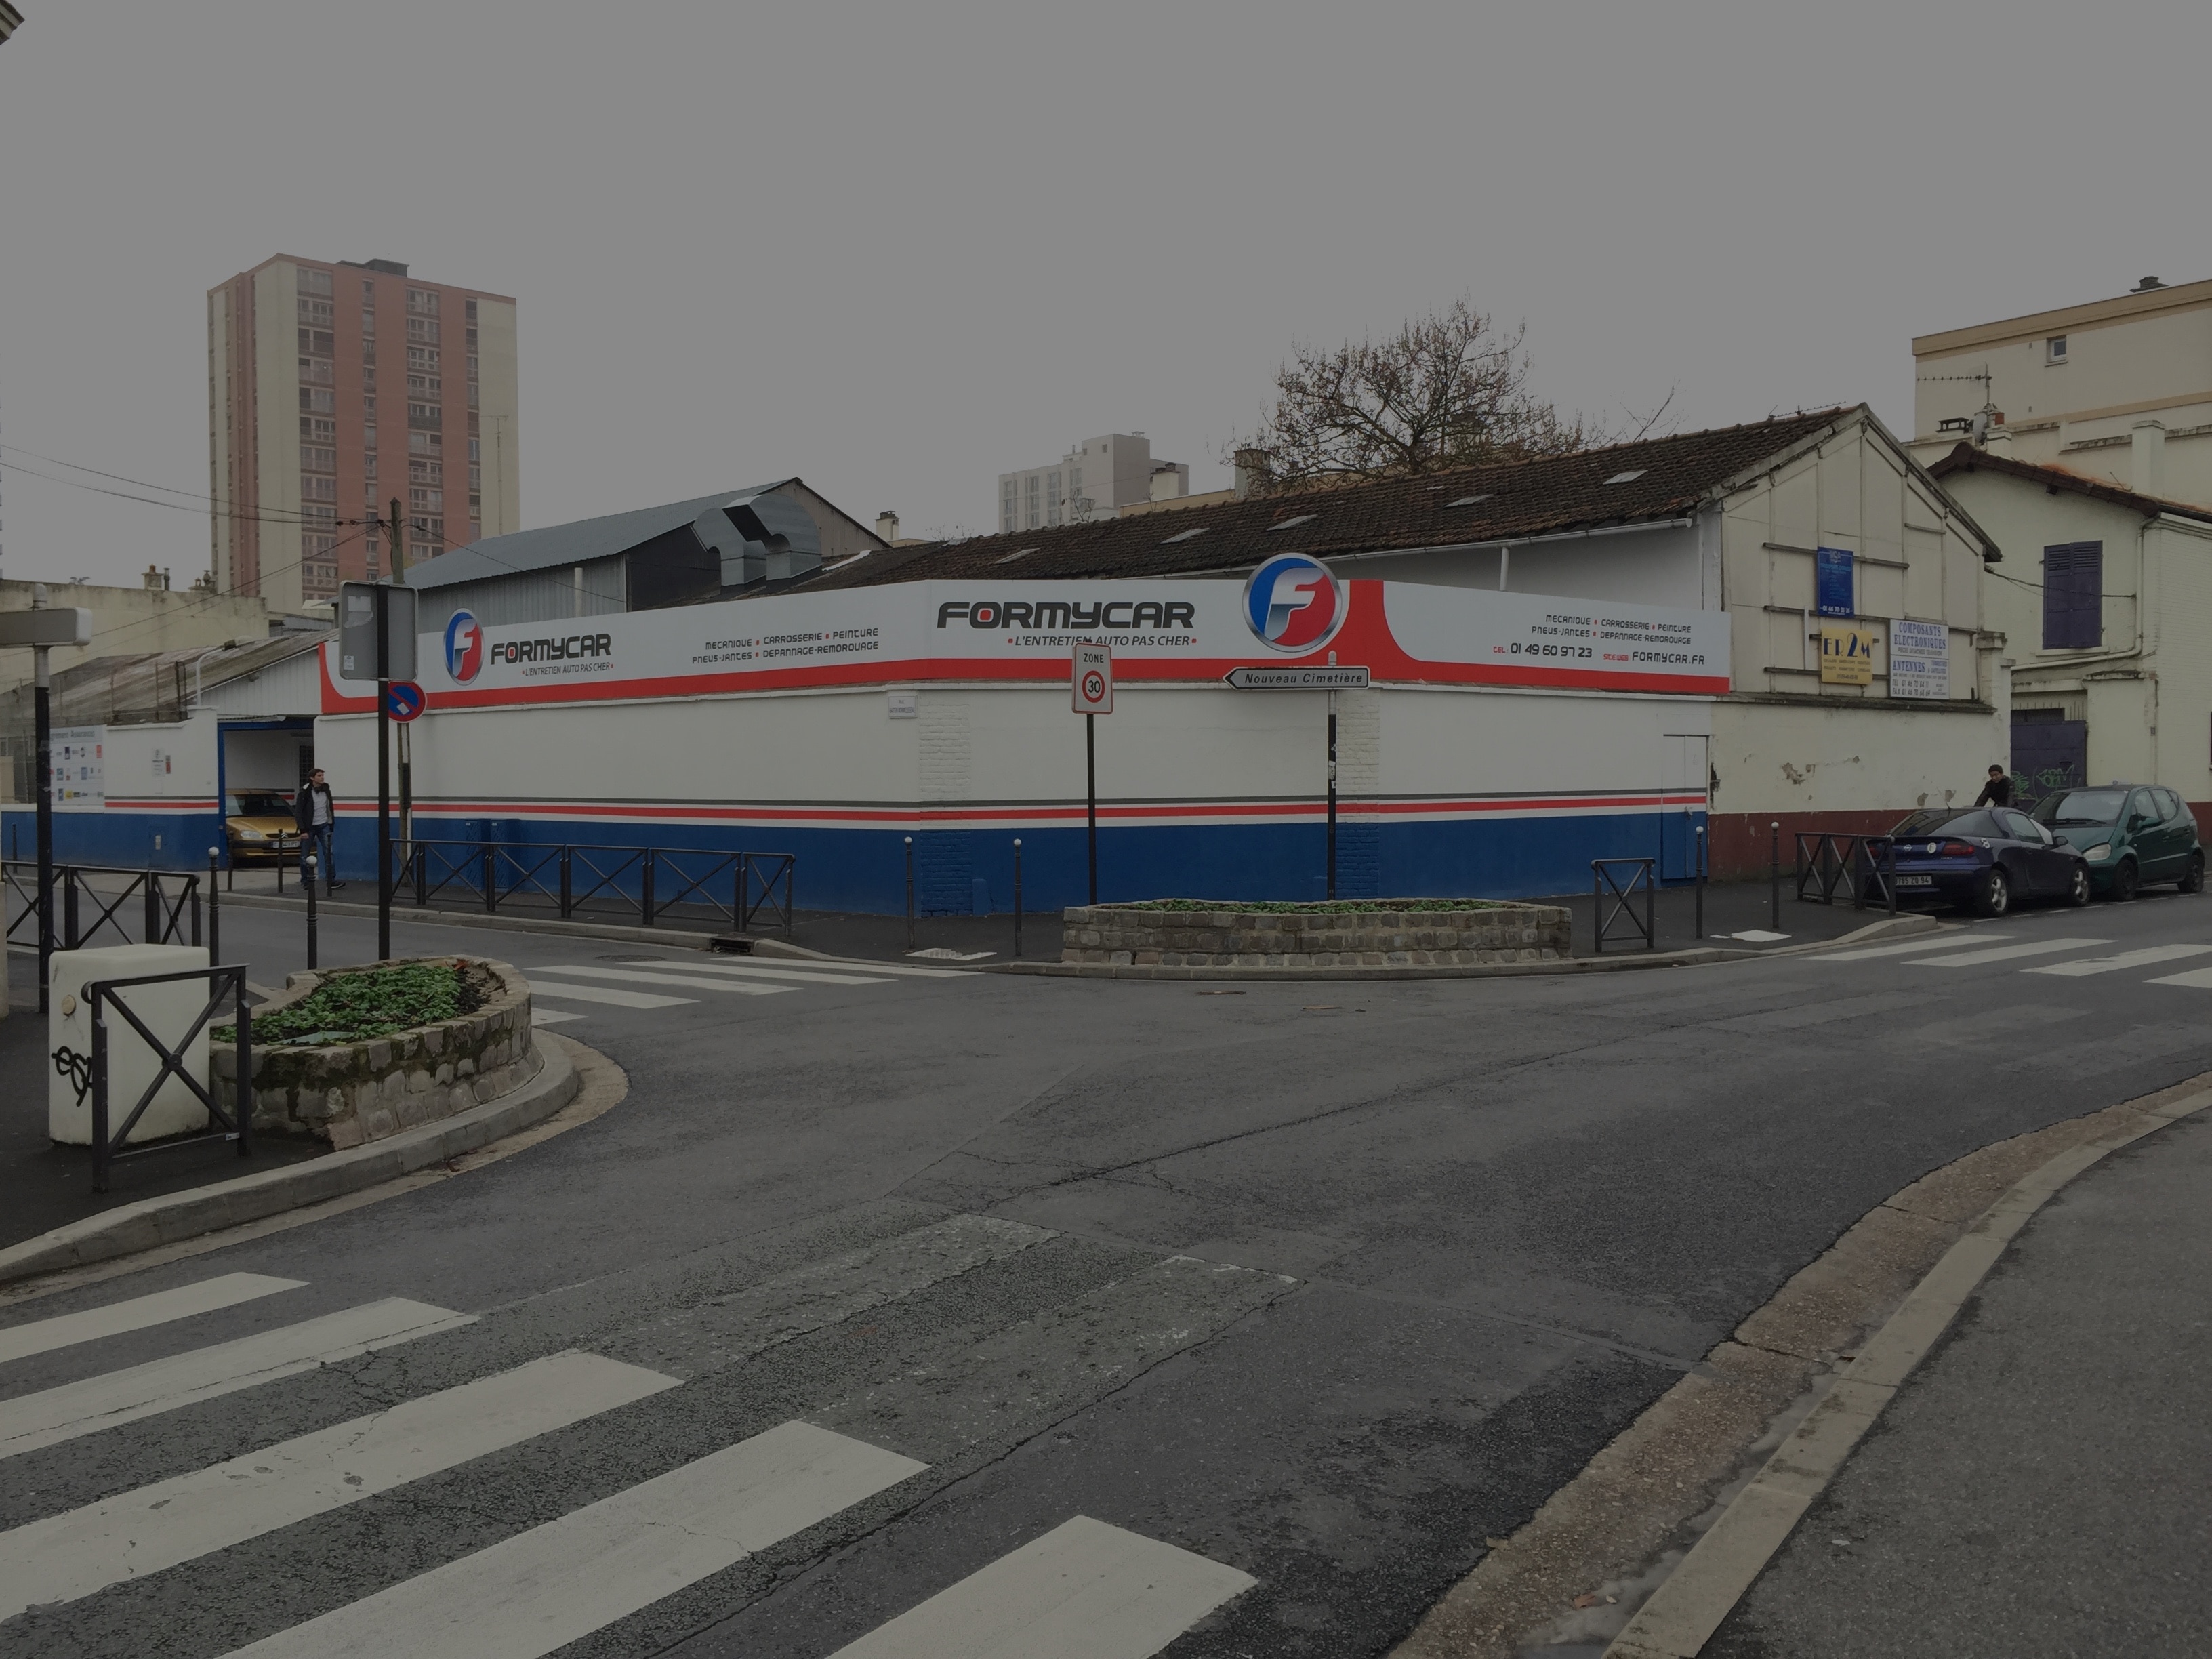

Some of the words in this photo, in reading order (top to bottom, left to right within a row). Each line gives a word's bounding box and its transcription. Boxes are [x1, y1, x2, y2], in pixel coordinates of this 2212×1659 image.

[937, 601, 1195, 629] FORMYCAR
[1545, 614, 1591, 626] MECANIQUE
[1601, 619, 1650, 630] CARROSSERIE
[1658, 623, 1692, 634] PEINTURE
[1899, 621, 1941, 637] COMPOSANTS
[705, 638, 752, 650] MECANIQUE
[763, 632, 823, 644] CARROSSERIE
[832, 628, 879, 640] PEINTURE
[1095, 636, 1130, 647] AUTO
[1132, 636, 1155, 647] PAS
[1157, 636, 1190, 647] CHER
[1531, 626, 1591, 638] PNEUS-JANTES
[1600, 631, 1692, 645] DEPANNAGE-REMORQUAGE
[1893, 634, 1946, 649] ELECTRONIQUES
[491, 633, 611, 665] FORMYCAR
[692, 652, 752, 664] PNEUS-JANTES
[762, 641, 879, 658] DEPANNAGE-REMORQUAGE
[1510, 642, 1521, 654] 01
[1524, 644, 1540, 655] 49
[1542, 644, 1558, 657] 60
[1560, 646, 1576, 657] 97
[1578, 647, 1593, 658] 23
[1631, 651, 1706, 665] FORMYCAR.FR
[1084, 653, 1104, 663] ZONE
[525, 665, 561, 676] L'ENTRETIEN
[562, 664, 580, 674] AUTO
[580, 663, 593, 673] PAS
[593, 662, 610, 672] CHER
[1892, 660, 1925, 673] ANTENNES
[1244, 673, 1297, 684] Nouveau
[1303, 672, 1363, 684] Cimetière
[1088, 680, 1101, 693] 30
